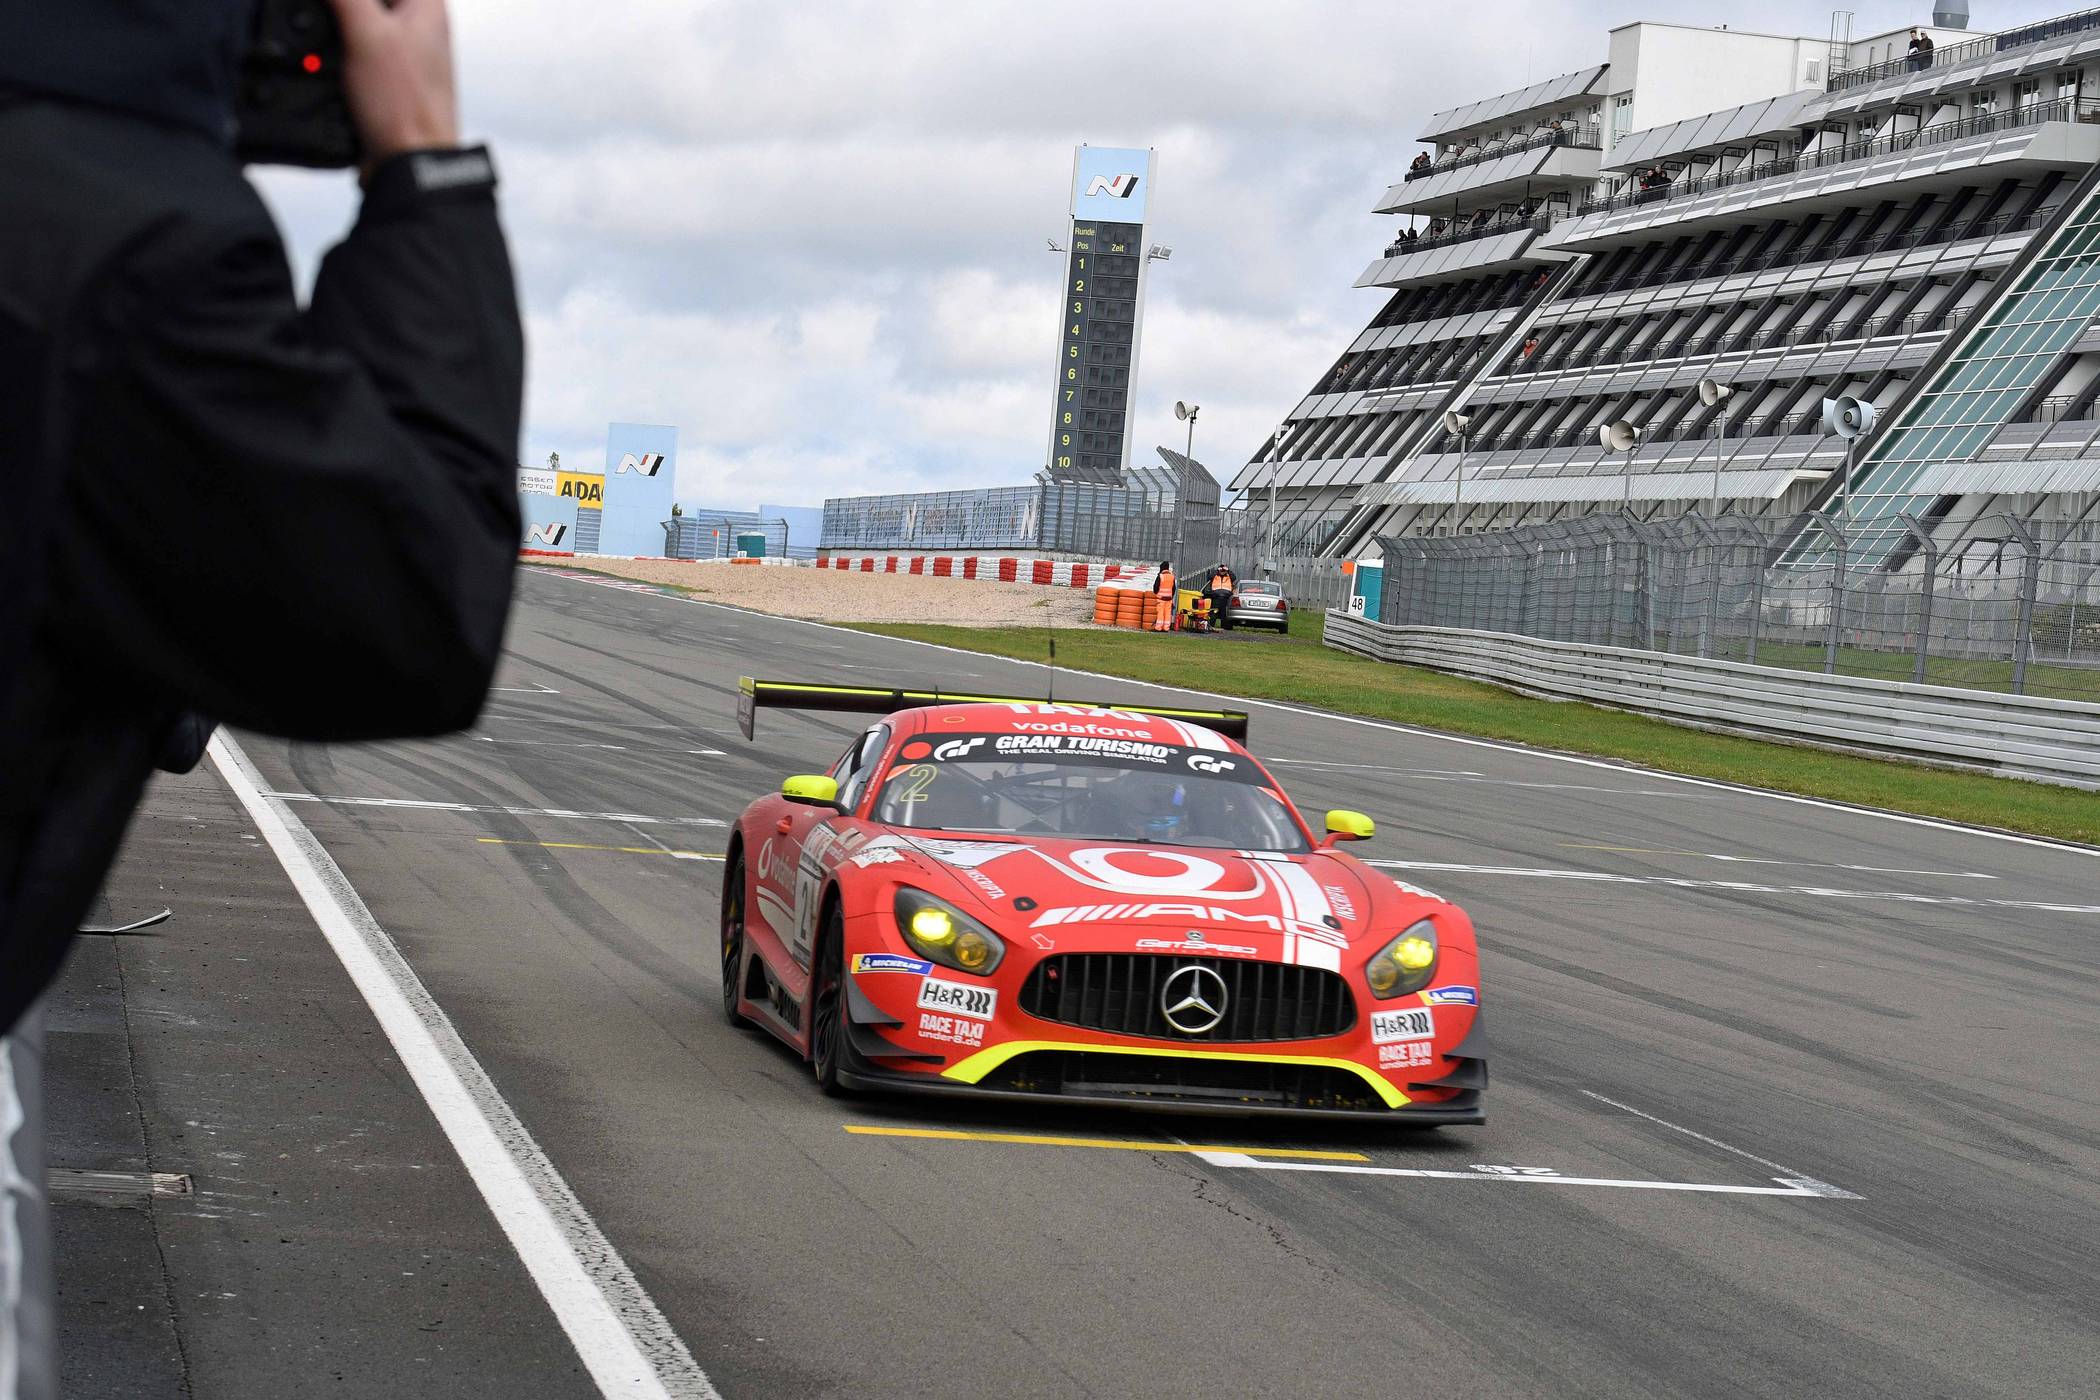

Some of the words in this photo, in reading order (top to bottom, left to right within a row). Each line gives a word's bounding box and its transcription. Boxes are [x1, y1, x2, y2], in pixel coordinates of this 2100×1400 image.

[1074, 226, 1095, 237] Runde
[1076, 241, 1089, 251] Pos
[1111, 243, 1125, 253] Zeit
[1079, 257, 1085, 269] 1
[1076, 280, 1084, 292] 2
[1073, 302, 1082, 313] 3
[1071, 324, 1080, 336] 4
[1070, 346, 1078, 358] 5
[1067, 368, 1076, 380] 6
[1065, 390, 1074, 402] 7
[1063, 412, 1072, 424] 8
[1061, 434, 1070, 446] 9
[1057, 456, 1071, 468] 10
[520, 476, 553, 484] ESSEN
[1351, 597, 1363, 611] 48
[1011, 721, 1152, 739] vodafone
[995, 735, 1062, 750] GRAN
[1054, 749, 1101, 757] DRIVING
[1103, 751, 1167, 764] SIMULATOR
[900, 764, 939, 802] 2
[922, 982, 964, 1007] H&R
[919, 1013, 952, 1034] RACE
[954, 1019, 985, 1040] TAXI
[1374, 1015, 1408, 1036] H&R
[1378, 1045, 1408, 1062] RACE
